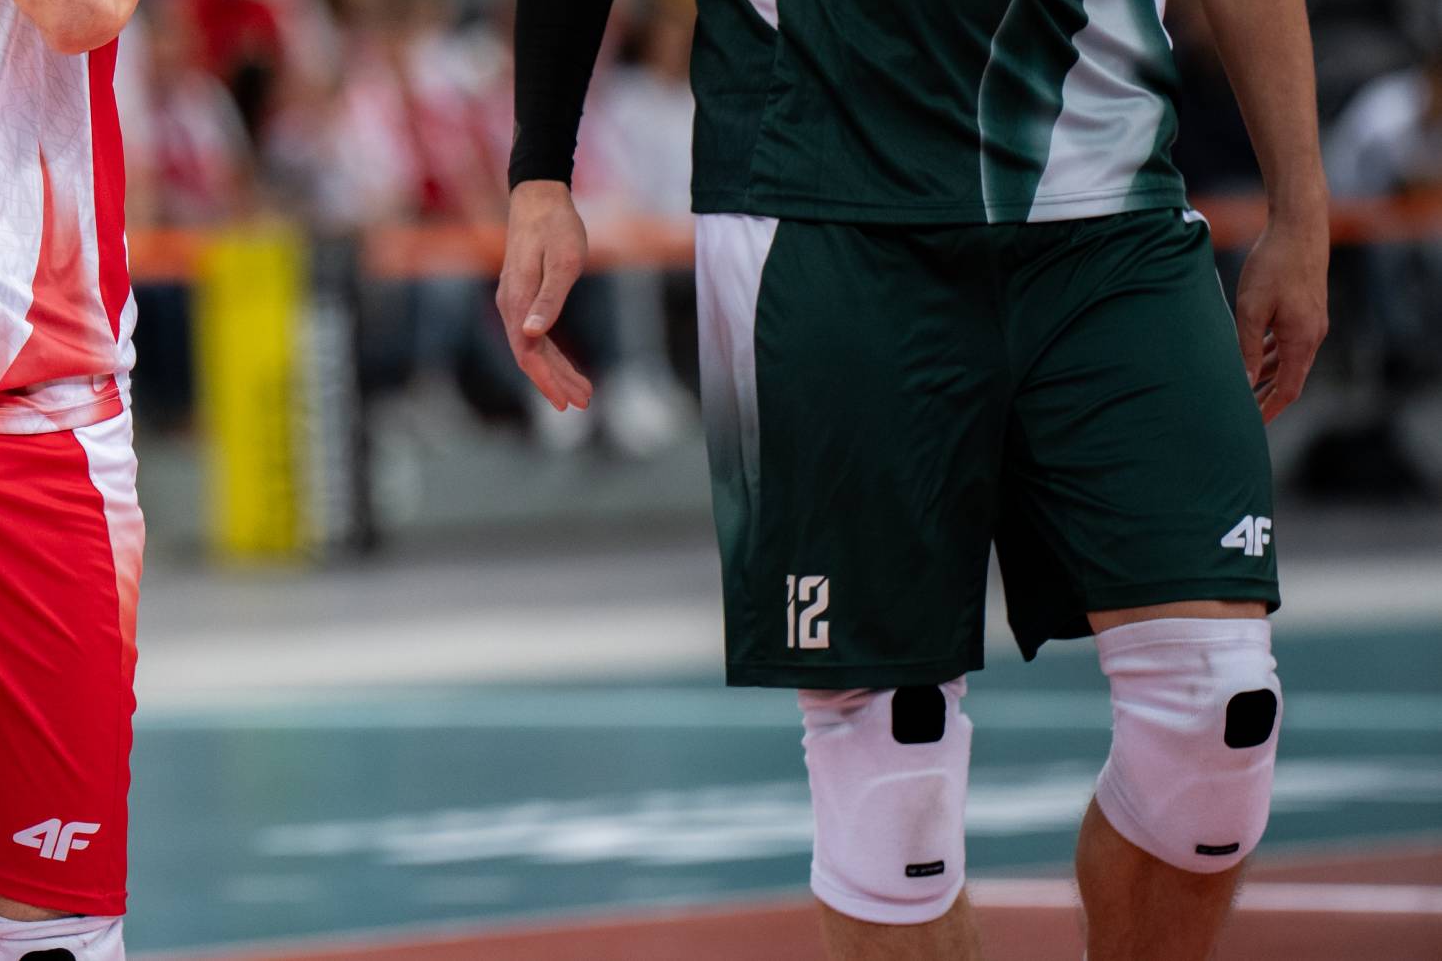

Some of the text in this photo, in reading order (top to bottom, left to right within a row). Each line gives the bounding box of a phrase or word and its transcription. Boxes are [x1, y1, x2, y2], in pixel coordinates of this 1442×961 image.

[1220, 515, 1272, 557] 4F
[785, 575, 830, 649] 12
[13, 818, 101, 862] 4F
